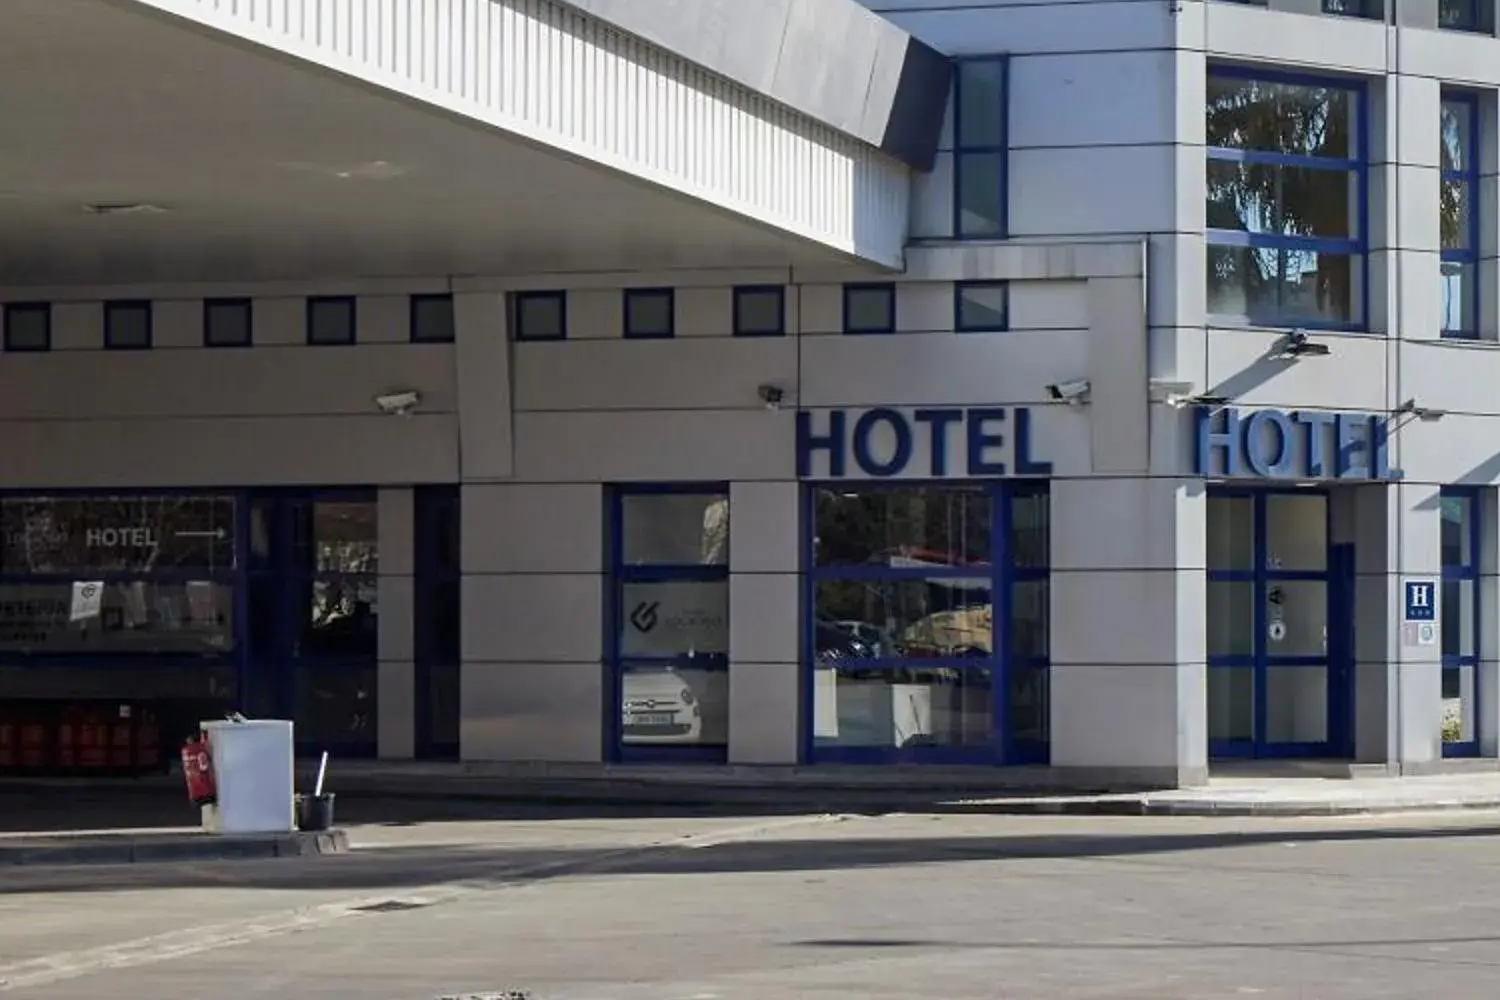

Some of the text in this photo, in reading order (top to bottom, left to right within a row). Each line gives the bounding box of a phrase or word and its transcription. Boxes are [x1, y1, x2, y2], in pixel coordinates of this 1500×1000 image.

[795, 407, 1054, 477] HOTEL
[1194, 405, 1405, 479] HOTEL
[86, 527, 158, 548] HOTEL
[1411, 585, 1429, 607] H
